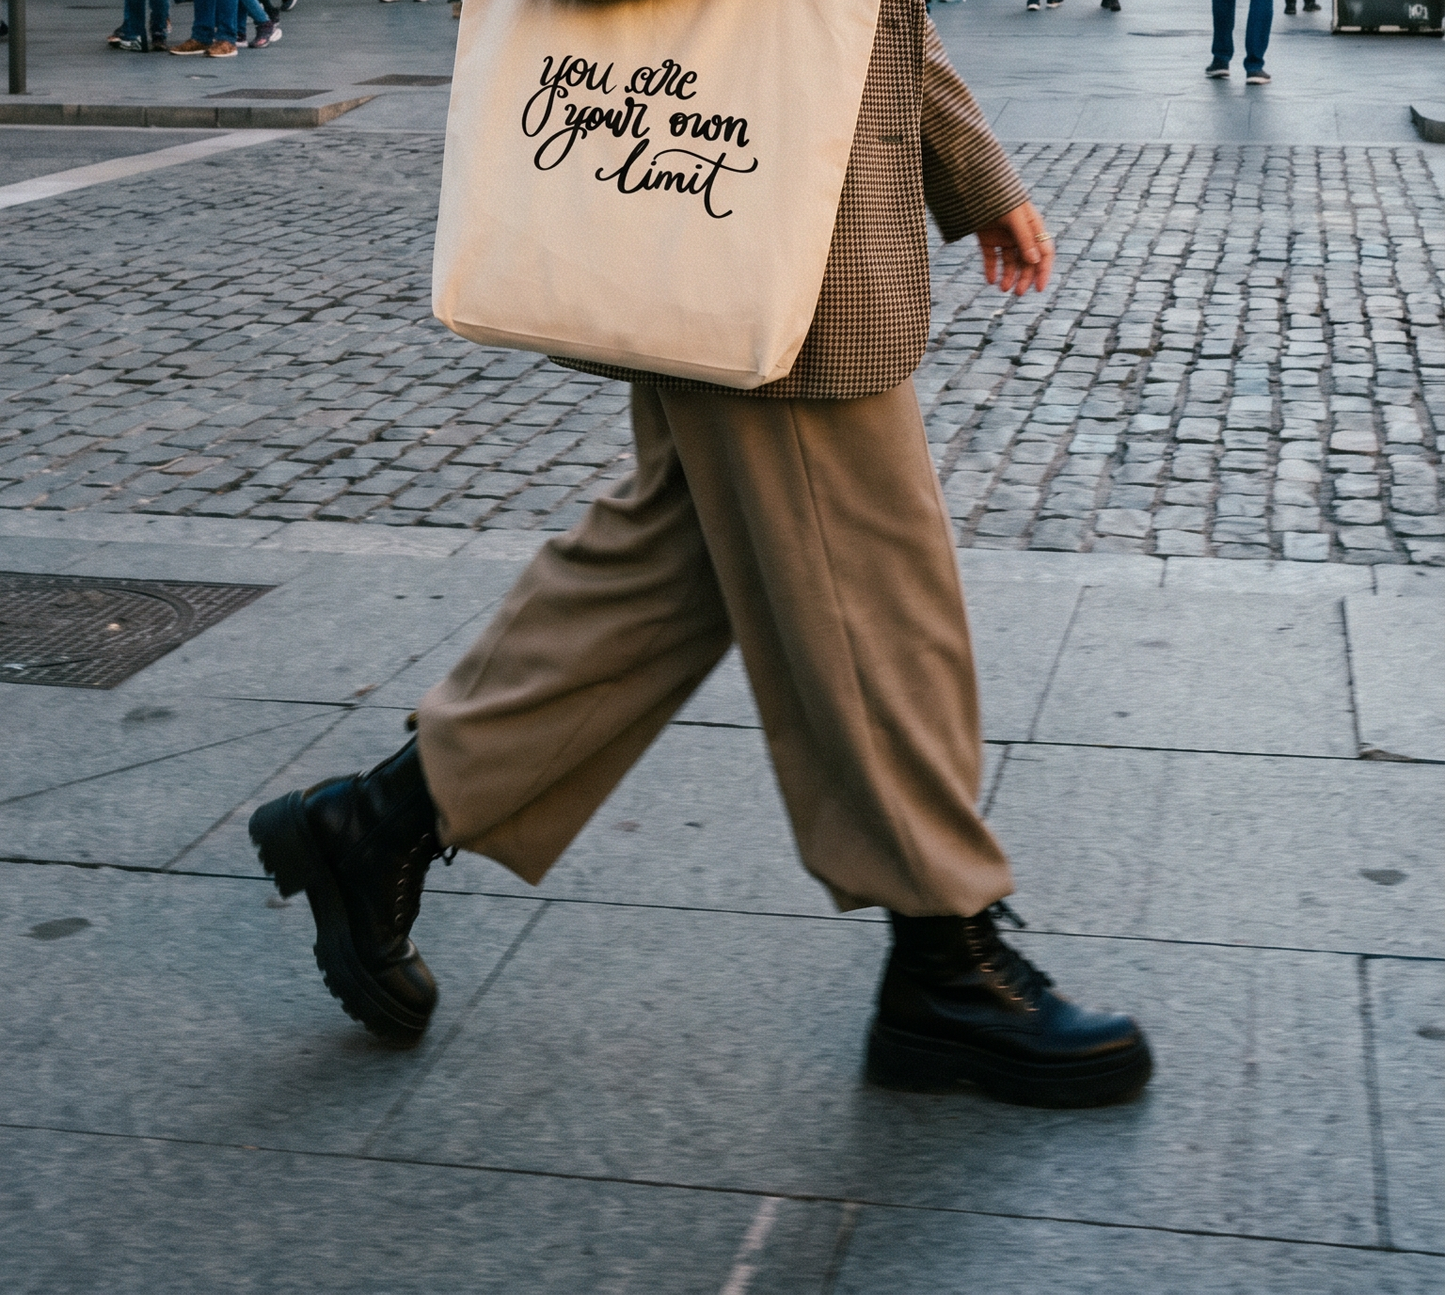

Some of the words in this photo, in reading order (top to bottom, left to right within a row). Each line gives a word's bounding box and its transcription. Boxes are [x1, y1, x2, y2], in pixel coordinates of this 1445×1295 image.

[521, 55, 617, 138] you
[624, 58, 698, 101] are
[533, 96, 651, 171] your
[668, 112, 750, 148] own
[594, 138, 759, 219] limit
